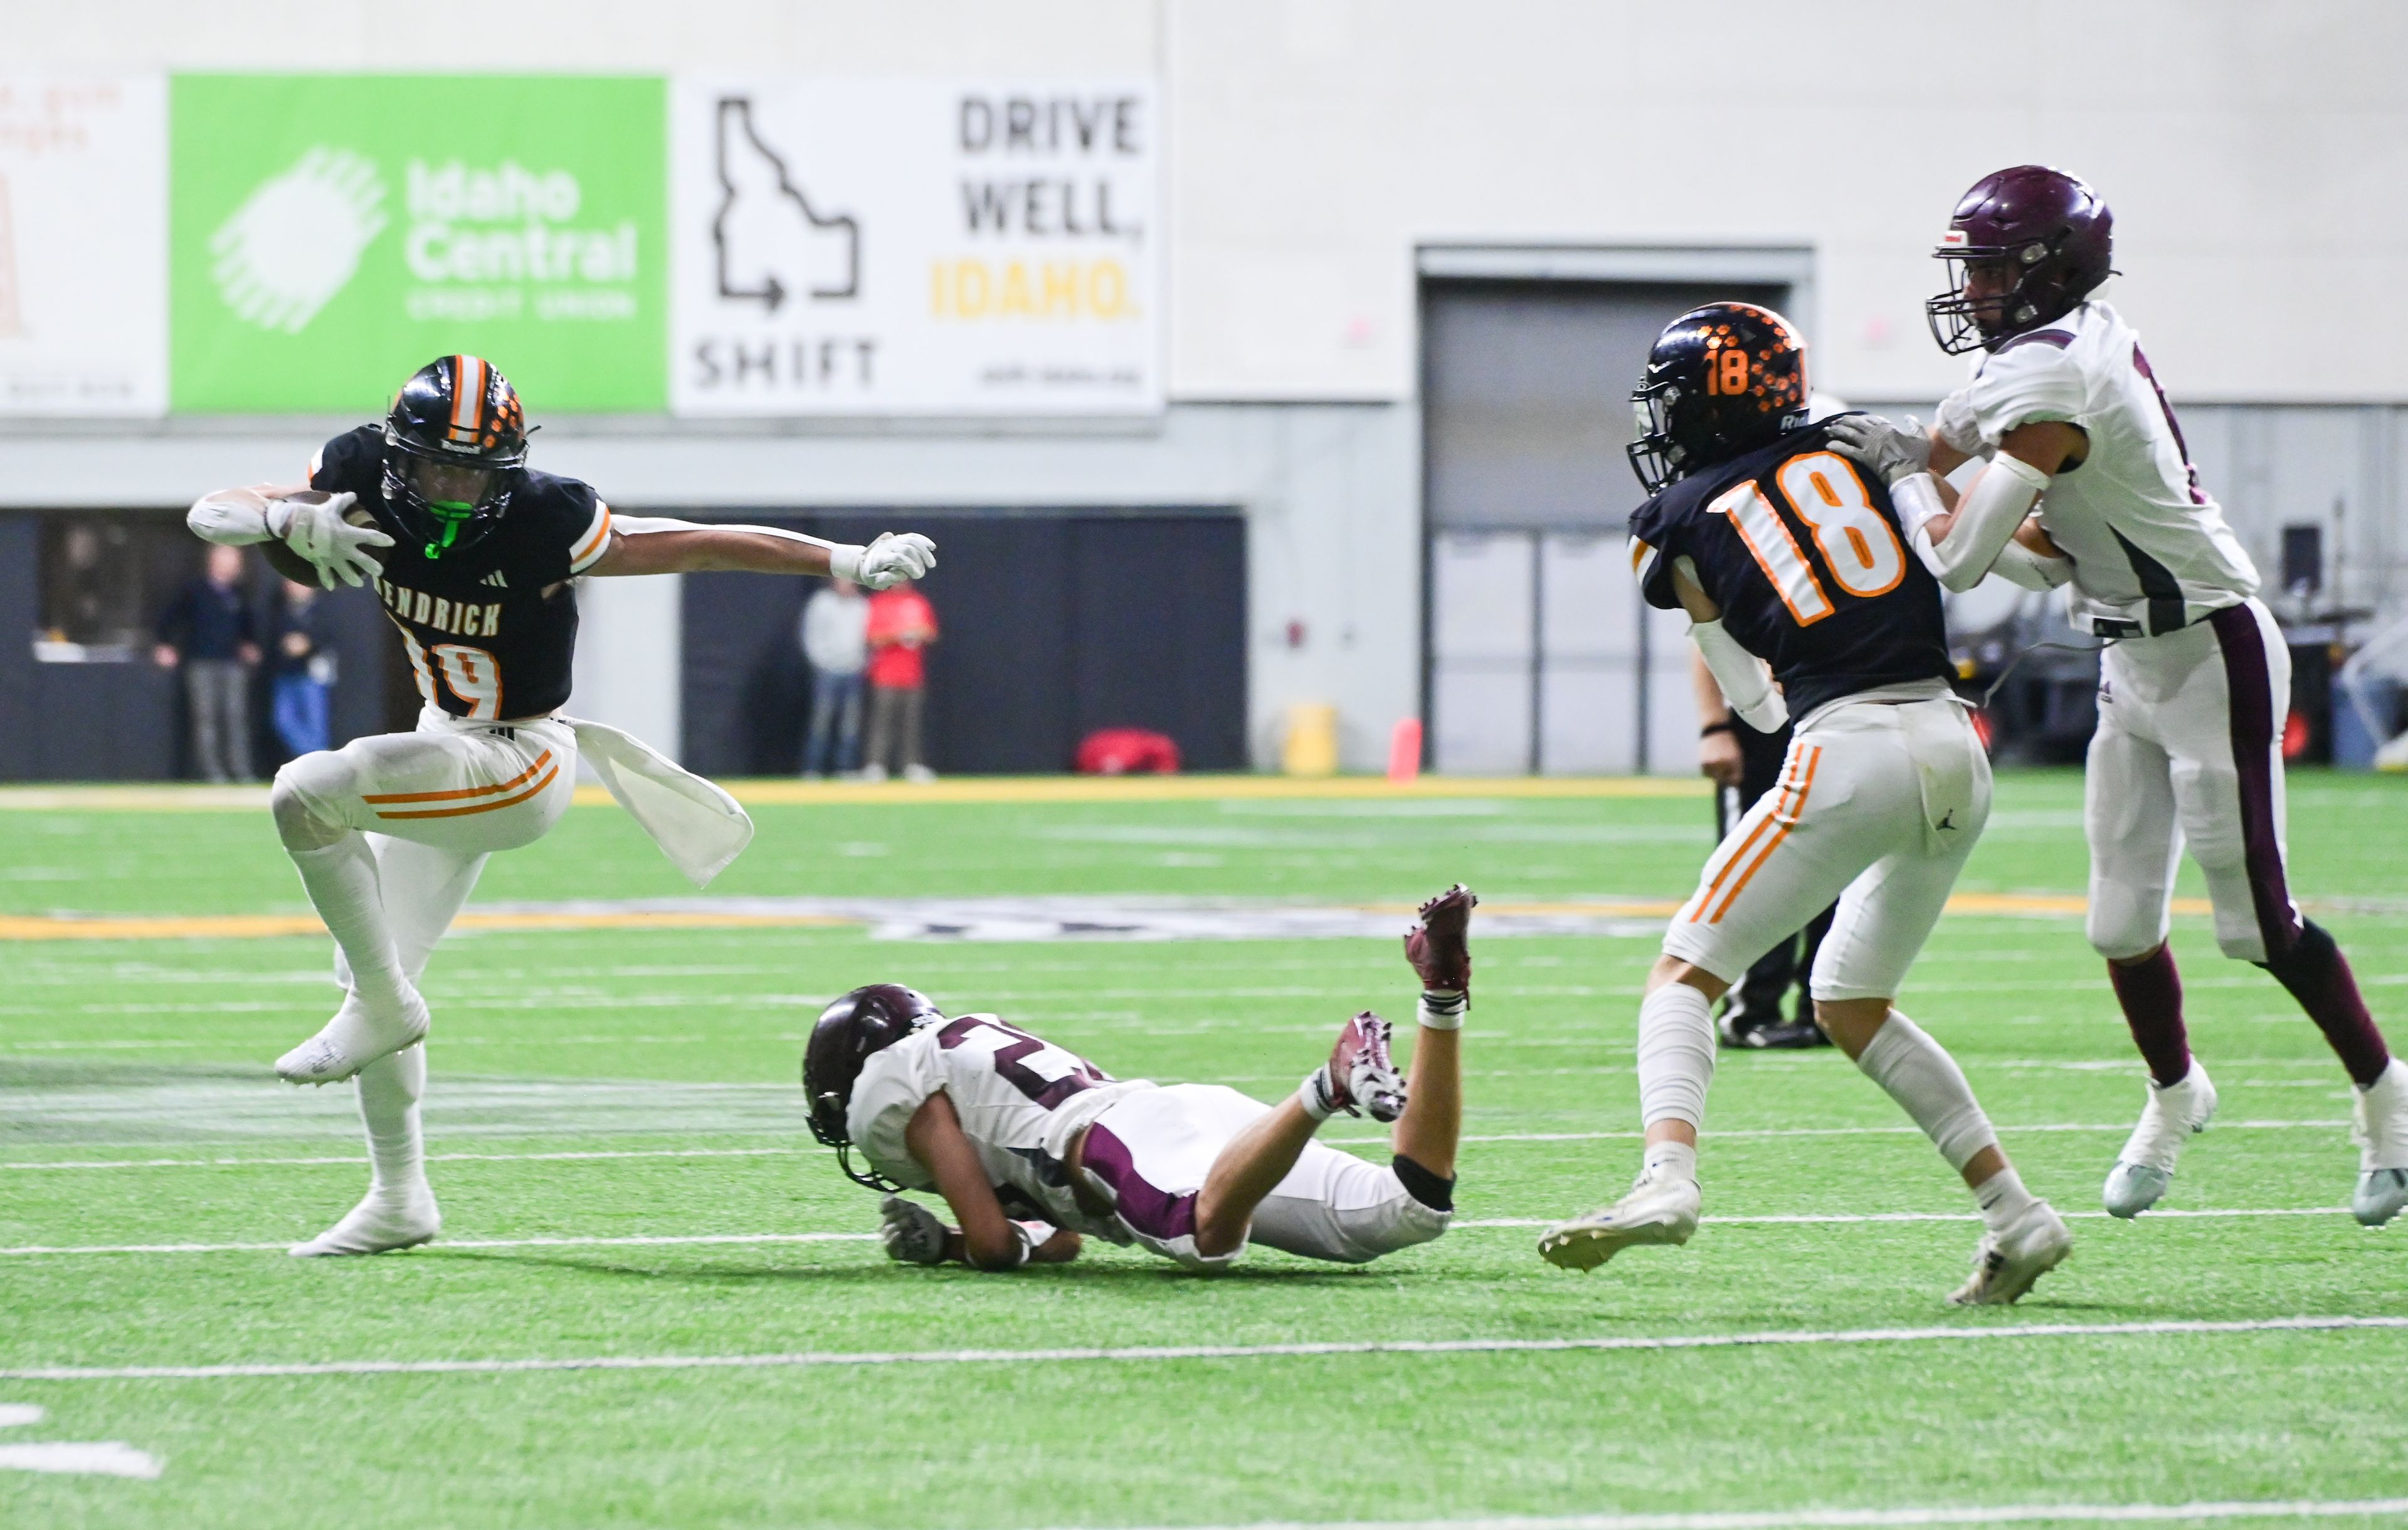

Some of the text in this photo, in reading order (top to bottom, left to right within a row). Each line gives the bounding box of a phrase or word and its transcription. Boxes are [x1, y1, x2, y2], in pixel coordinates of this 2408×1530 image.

[959, 95, 1140, 154] DRIVE
[408, 162, 578, 219] Idaho
[961, 178, 1143, 251] WELL,
[406, 226, 635, 280] Central
[932, 260, 1142, 318] IDAHO.
[694, 339, 877, 387] SHIFT
[1703, 349, 1748, 396] 18
[1706, 450, 1906, 628] 18
[385, 608, 503, 720] 19
